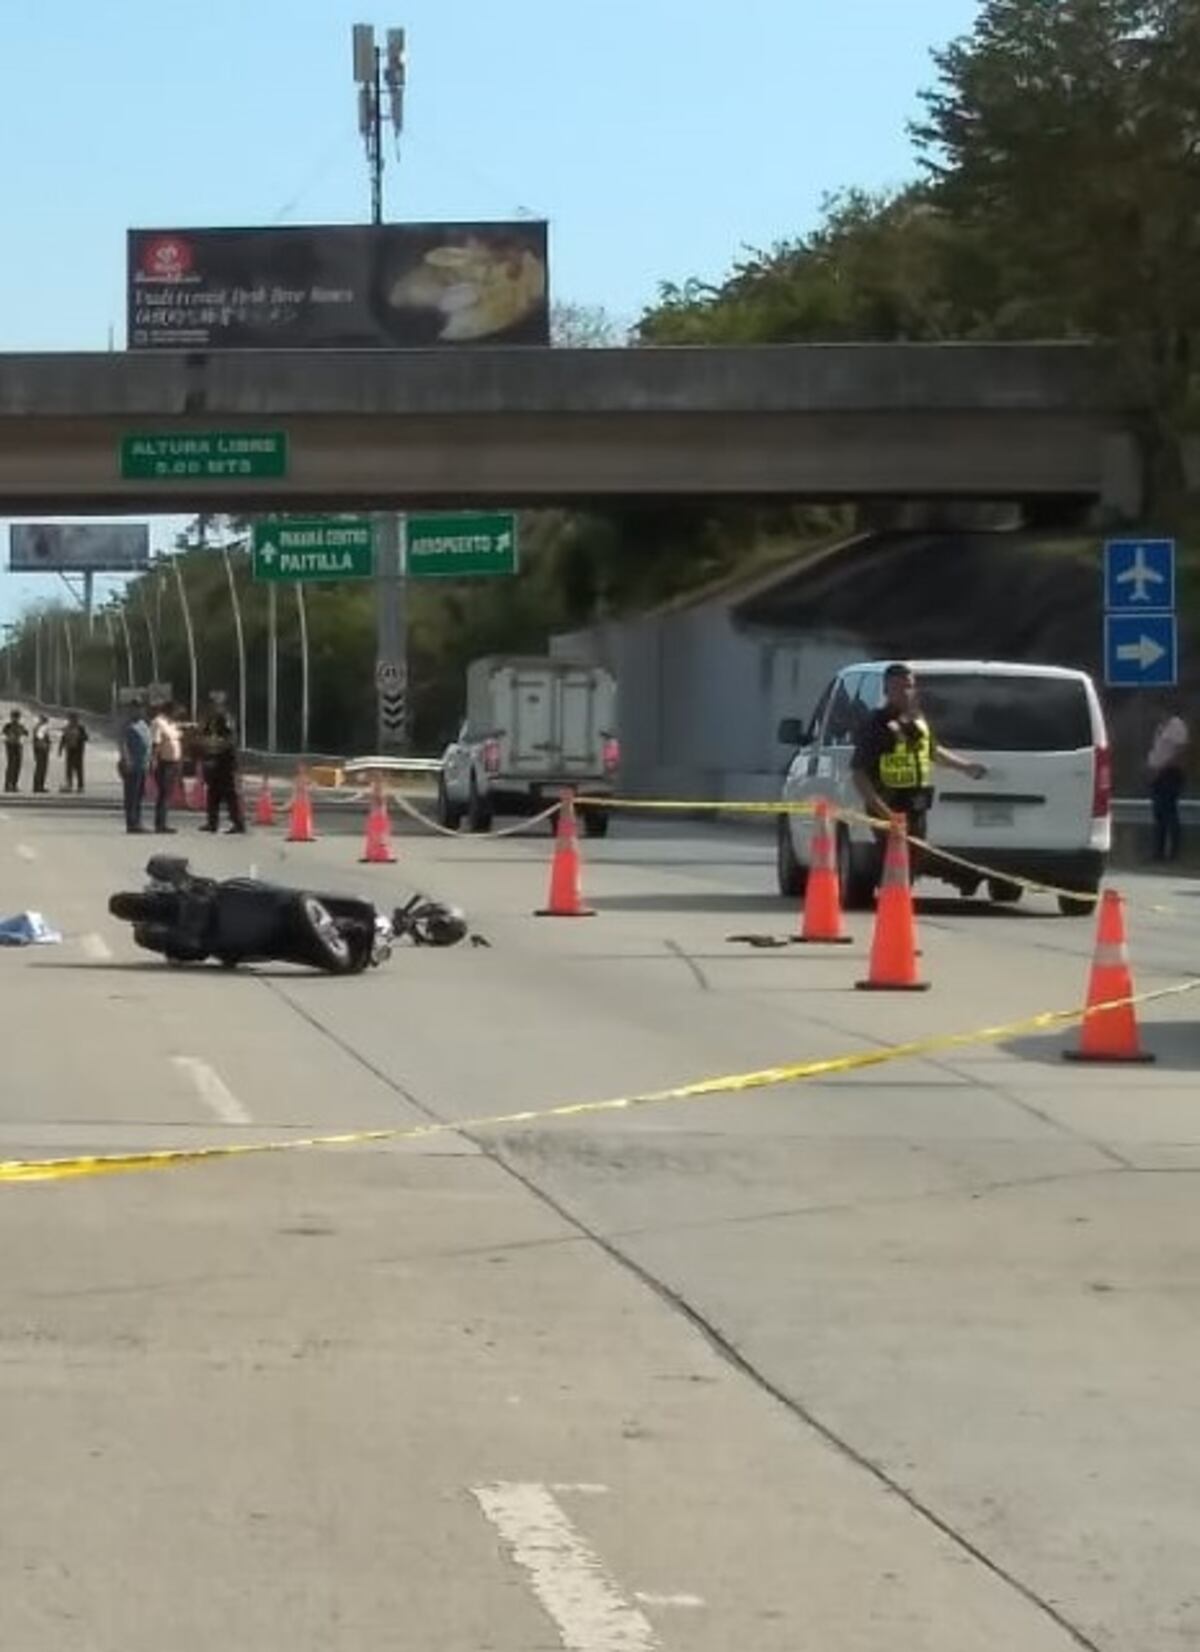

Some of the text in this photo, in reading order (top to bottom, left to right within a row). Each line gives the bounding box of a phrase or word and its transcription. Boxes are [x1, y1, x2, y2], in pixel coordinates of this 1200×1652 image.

[131, 437, 277, 455] ALTURA LIBRE
[280, 551, 353, 572] PAITILLA
